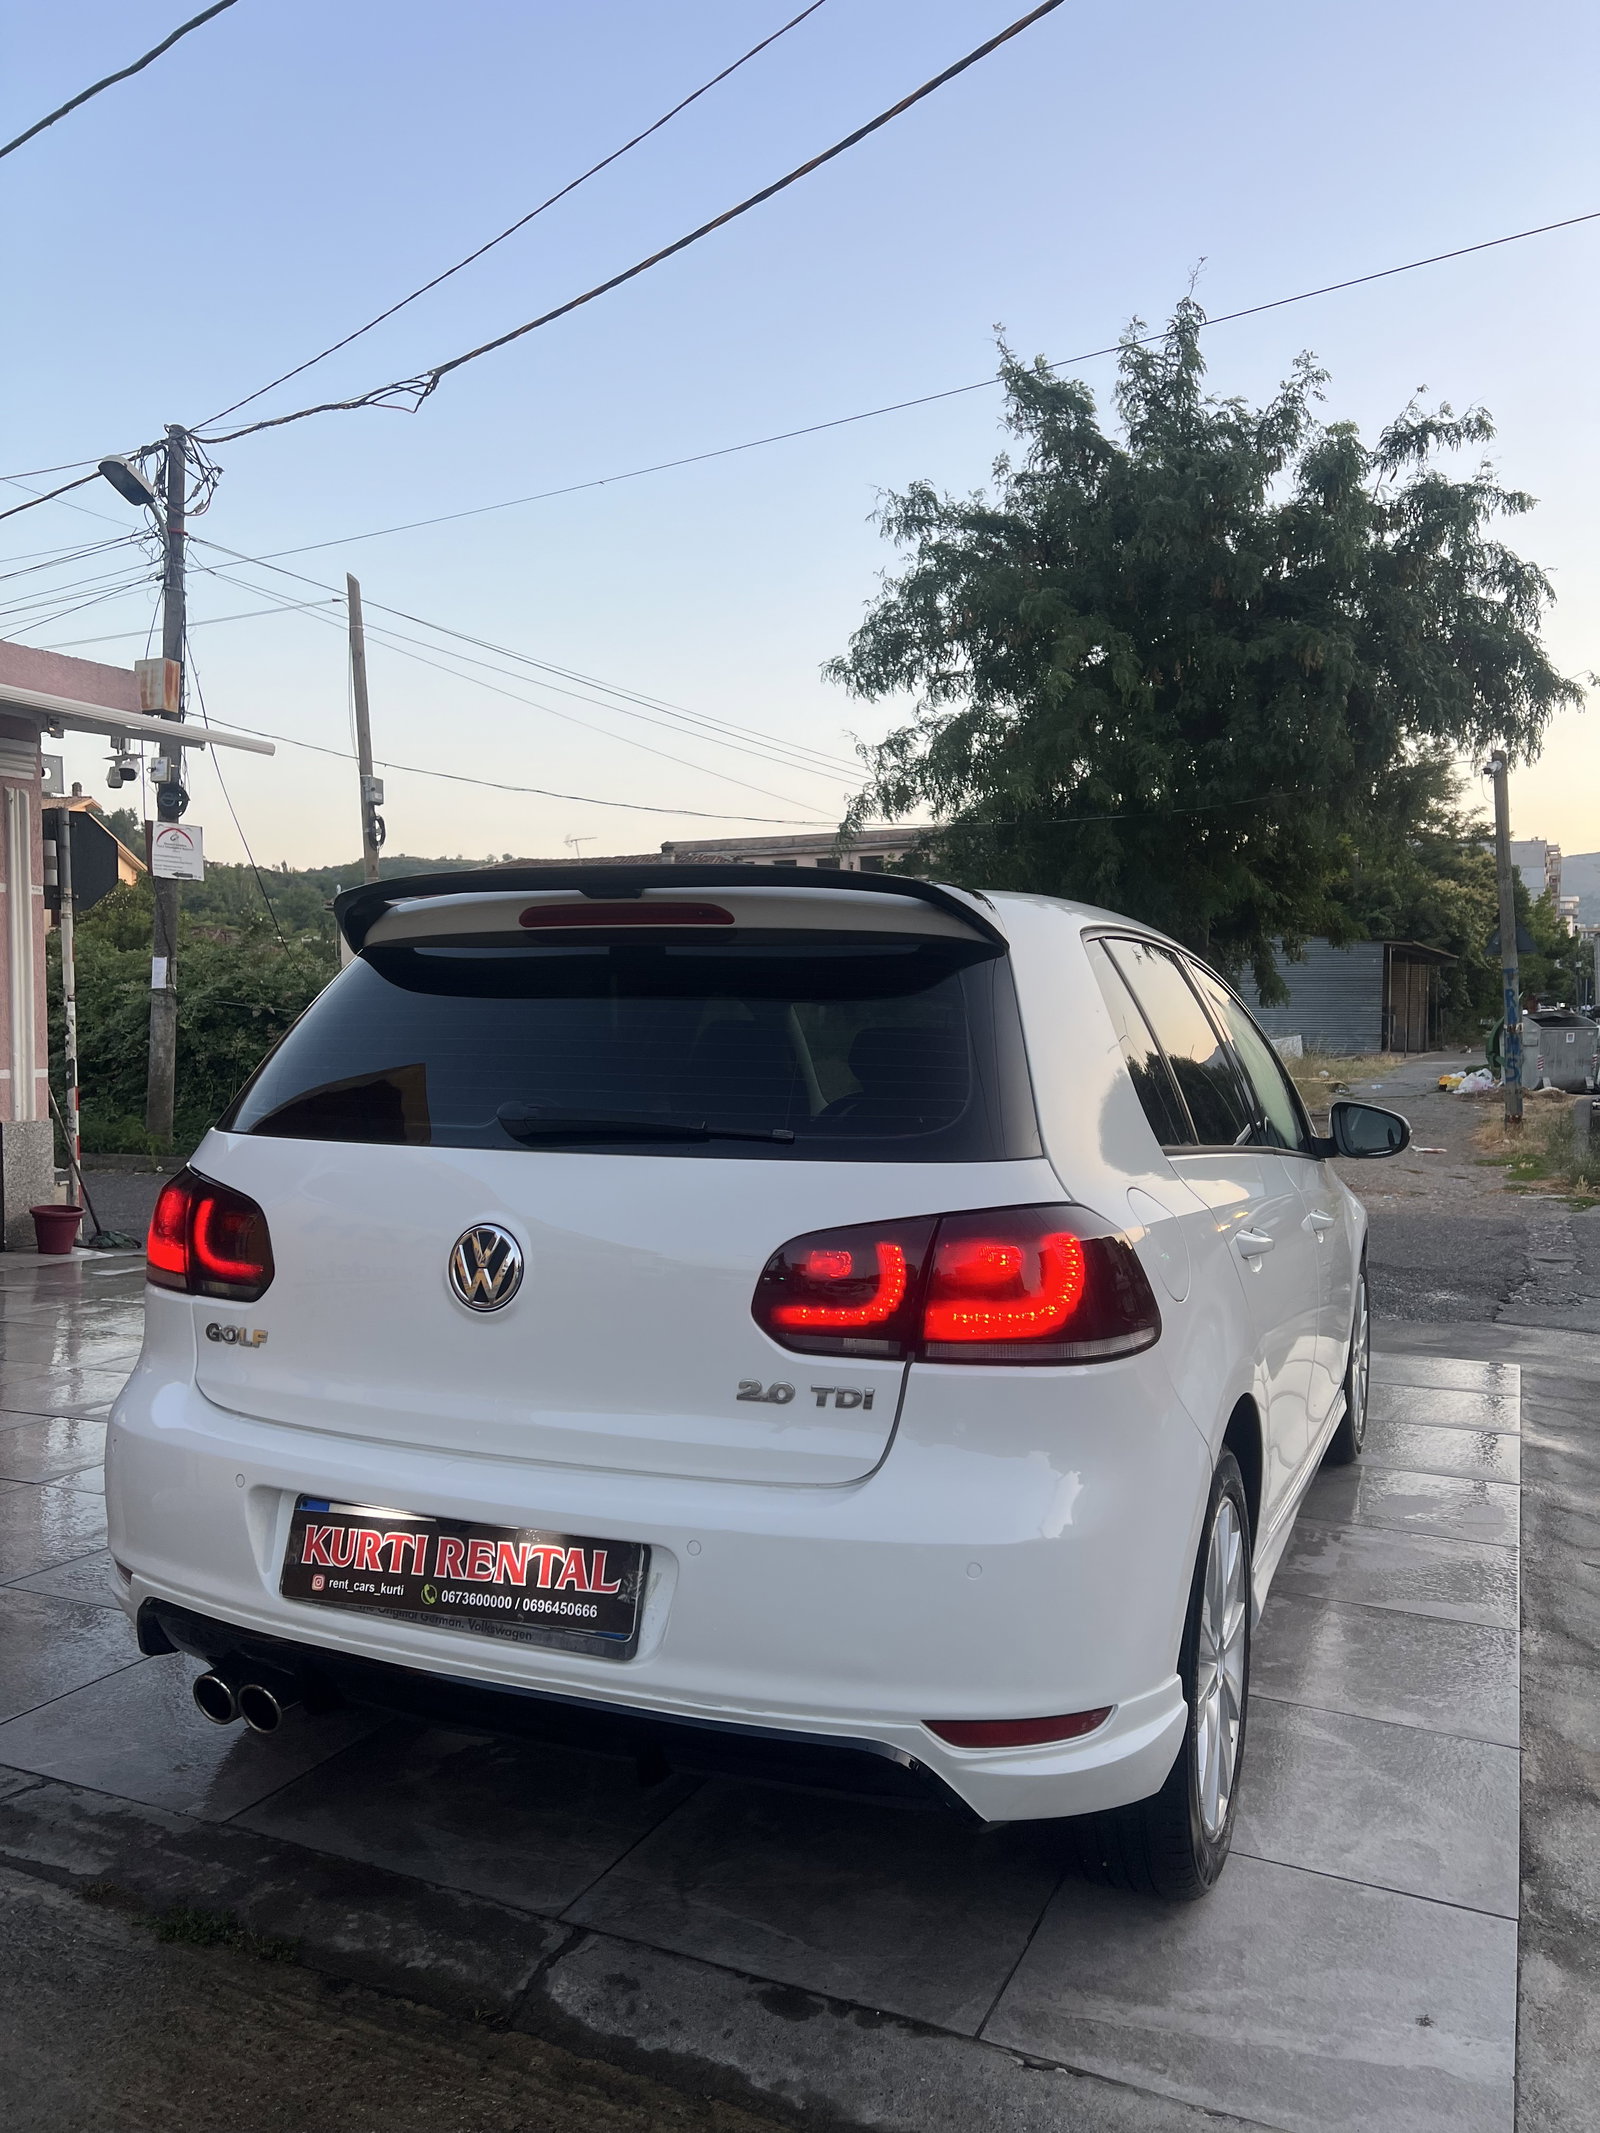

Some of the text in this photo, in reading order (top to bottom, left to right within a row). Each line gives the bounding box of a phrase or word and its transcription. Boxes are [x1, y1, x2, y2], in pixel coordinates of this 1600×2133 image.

[453, 1227, 519, 1308] VW
[206, 1322, 269, 1348] GOLF
[736, 1379, 796, 1404] 2.0
[301, 1524, 623, 1594] KURTI RENTAL
[328, 1579, 404, 1596] rent_cars_kurti
[441, 1590, 512, 1609] 0673600000
[522, 1598, 598, 1618] 0696450666
[468, 1618, 532, 1641] Volkswagen
